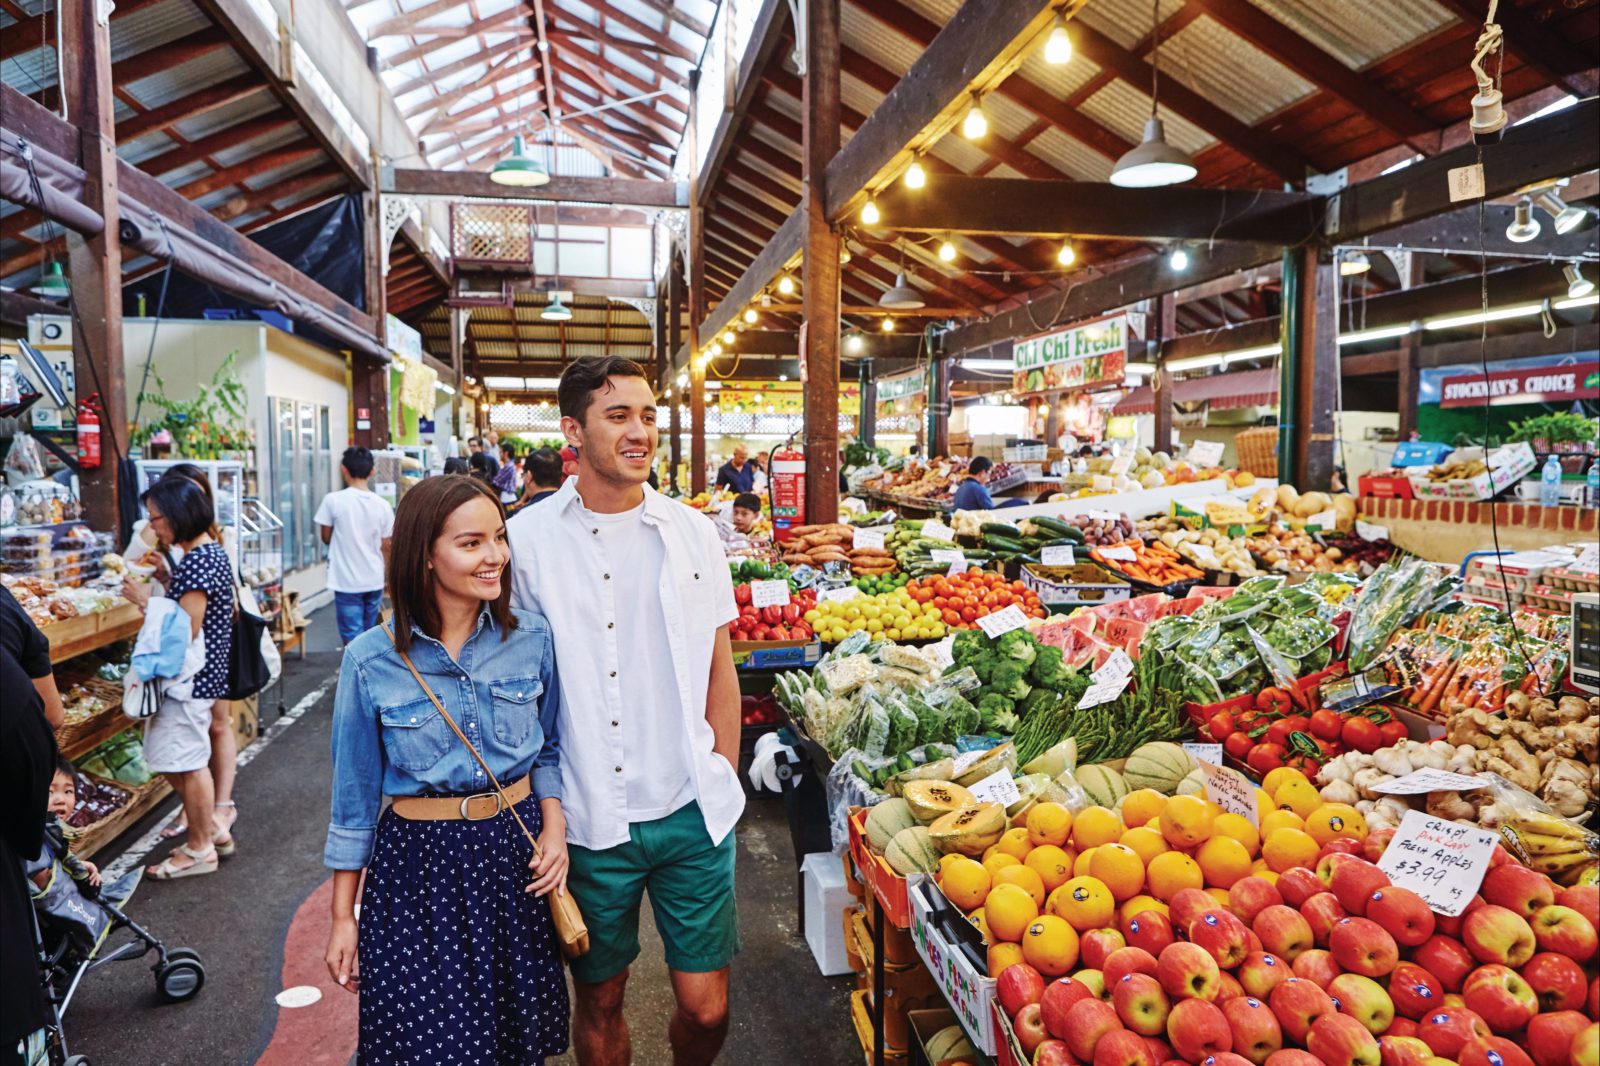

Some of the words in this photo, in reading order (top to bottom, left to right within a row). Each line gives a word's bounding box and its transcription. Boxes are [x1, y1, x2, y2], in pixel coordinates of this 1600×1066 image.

[1042, 333, 1070, 362] Chi
[1075, 322, 1120, 355] Fresh
[1445, 379, 1518, 400] STOCKMAN'S
[1525, 374, 1576, 393] CHOICE
[1425, 821, 1469, 838] CRISPY
[1397, 839, 1429, 854] FRESH
[1395, 860, 1447, 886] $3.99
[947, 958, 970, 1002] FROM
[945, 977, 961, 1011] OUR
[960, 998, 981, 1037] FARM
